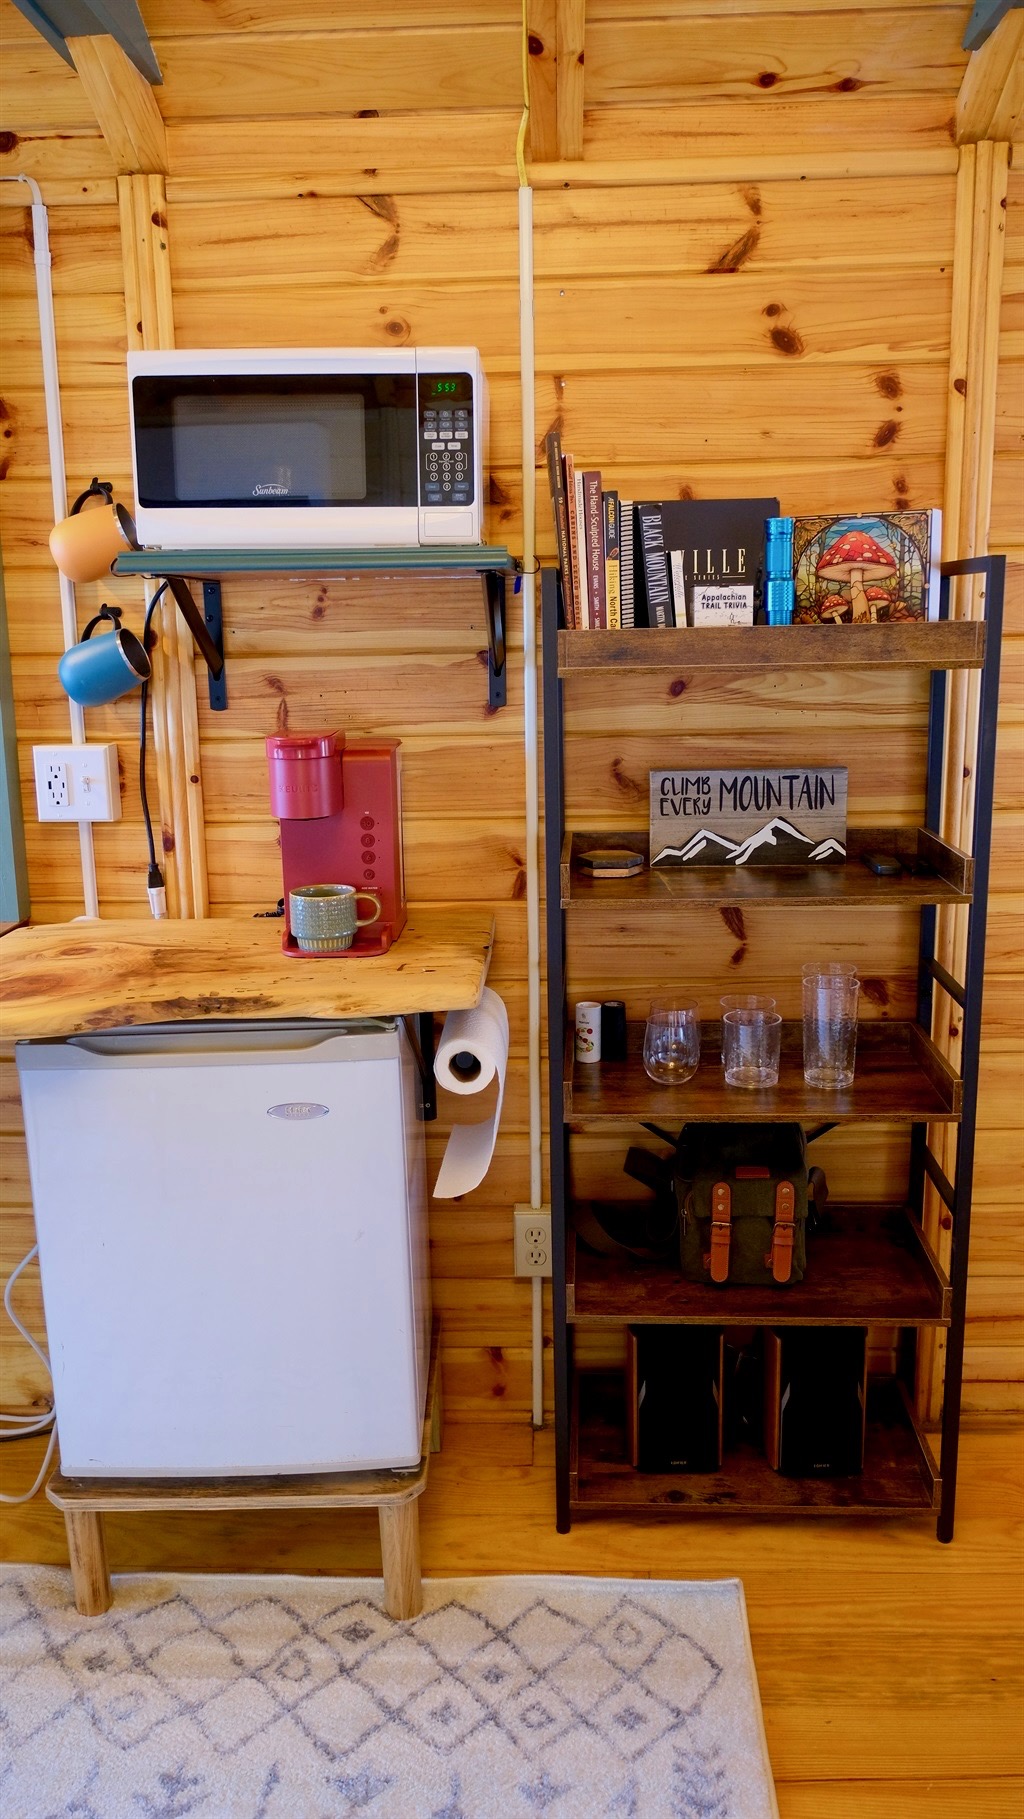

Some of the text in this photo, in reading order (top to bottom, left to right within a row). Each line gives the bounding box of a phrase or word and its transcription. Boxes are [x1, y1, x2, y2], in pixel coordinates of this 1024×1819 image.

[252, 484, 289, 497] Sunbeam
[590, 480, 598, 494] The
[590, 496, 600, 548] Hand-Sculpted
[641, 515, 664, 549] BLACK
[592, 550, 600, 571] House
[609, 564, 618, 595] Hiking
[645, 551, 669, 604] MOUNTAIN
[609, 596, 618, 617] North
[701, 593, 747, 602] Appalachian
[701, 602, 722, 610] TRAIL
[660, 775, 712, 797] CLIMB
[718, 774, 836, 812] MOUNTAIN
[659, 796, 712, 816] EVERY
